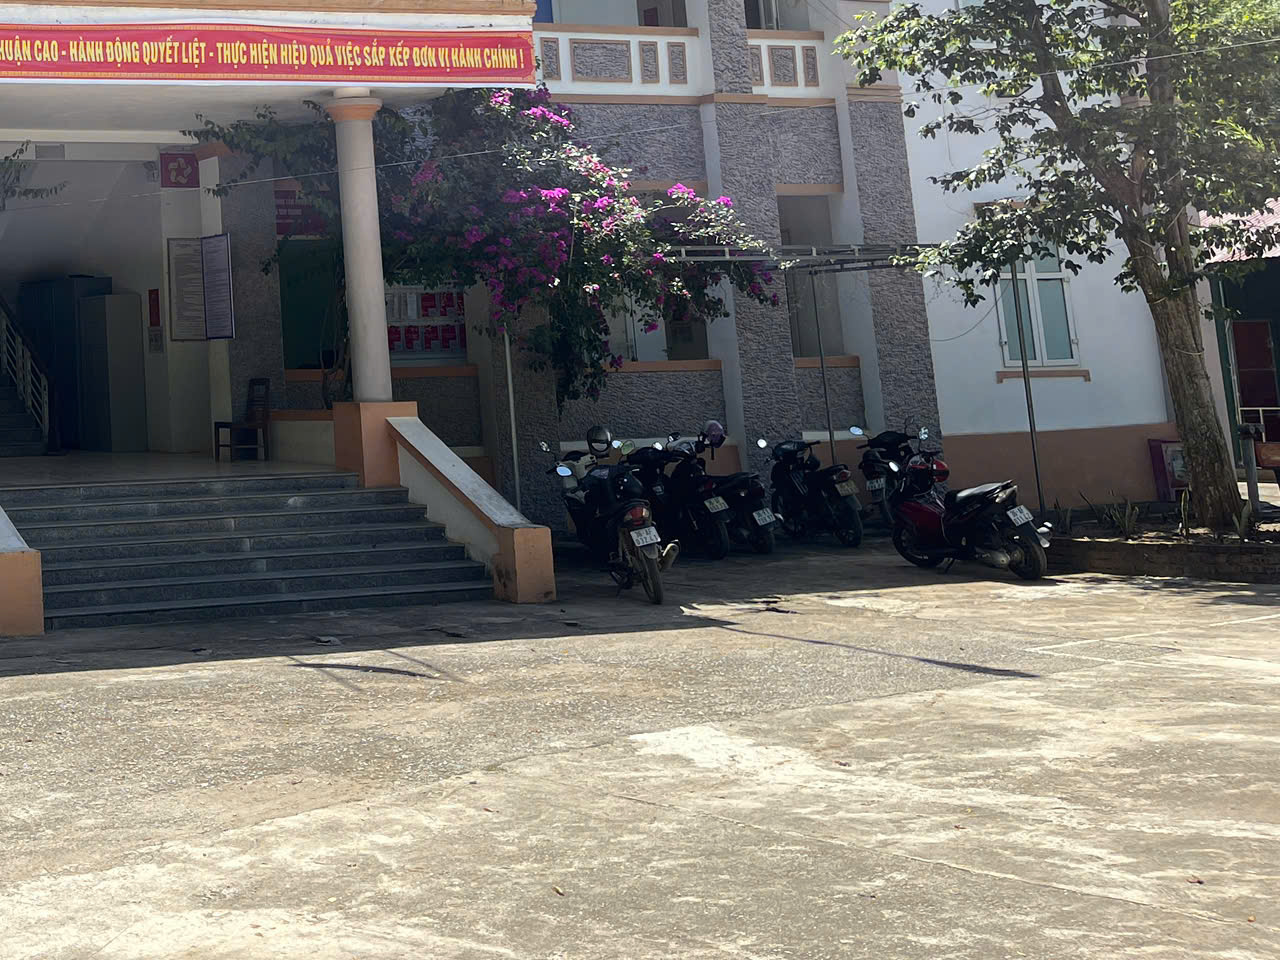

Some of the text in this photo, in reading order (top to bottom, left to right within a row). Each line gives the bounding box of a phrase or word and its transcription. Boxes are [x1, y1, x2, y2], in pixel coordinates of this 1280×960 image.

[33, 40, 59, 62] CAO
[70, 36, 104, 63] HÀNH
[105, 36, 140, 68] ĐỘNG
[142, 35, 179, 66] QUYẾT
[181, 37, 207, 68] LIỆT
[216, 41, 247, 69] THỰC
[249, 39, 278, 70] HIỆN
[280, 40, 308, 70] HIỆU
[309, 38, 334, 68] QUẢ
[334, 41, 362, 71] VIỆC
[363, 39, 386, 67] SẮP
[412, 44, 437, 68] ĐƠN
[438, 47, 451, 72] VỊ
[451, 43, 481, 69] HÀNH
[483, 44, 518, 69] CHÍNH
